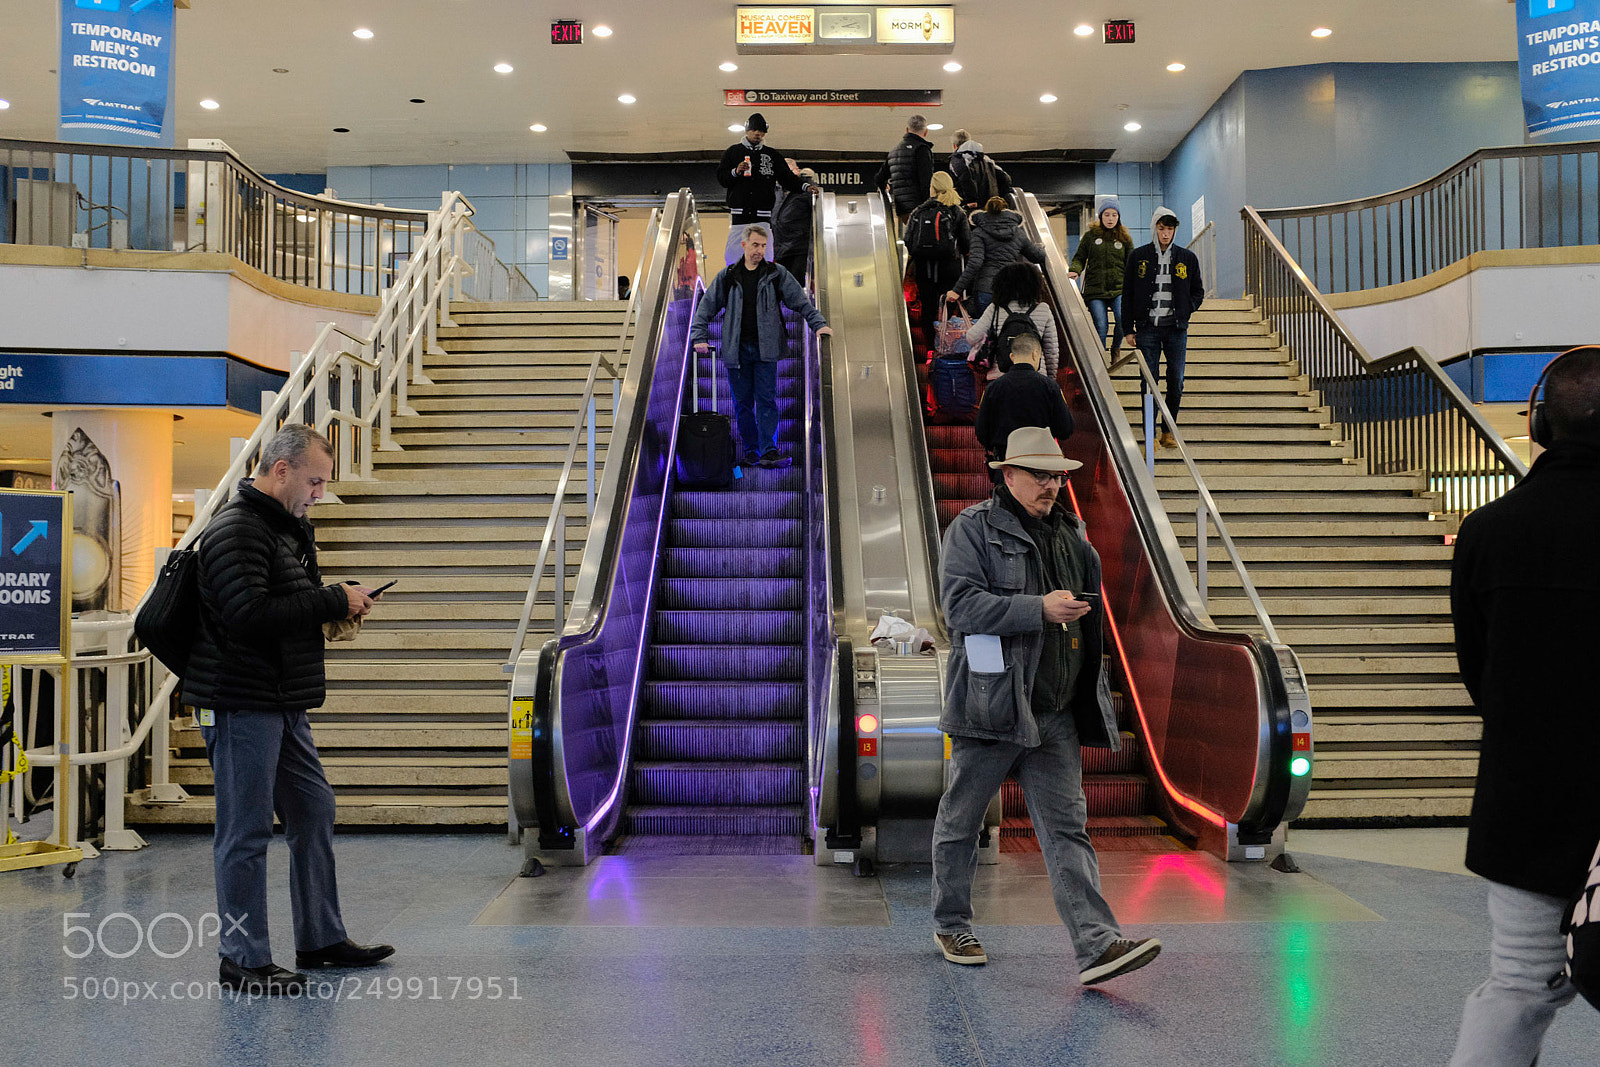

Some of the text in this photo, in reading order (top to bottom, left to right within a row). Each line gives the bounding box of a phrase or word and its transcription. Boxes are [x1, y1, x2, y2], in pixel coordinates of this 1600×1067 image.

[70, 22, 162, 47] TEMPORARY
[554, 25, 580, 41] EXIT
[741, 21, 812, 34] HEAVEN
[1107, 24, 1133, 40] EXIT
[1526, 20, 1600, 46] TEMPORA
[90, 39, 139, 58] MEN'S
[1549, 36, 1599, 56] MEN'S
[73, 54, 156, 77] RESTROOM
[1532, 51, 1600, 76] RESTROO
[727, 92, 860, 102] Exit To Taxiway and Street
[98, 101, 142, 111] AMTRAK
[813, 172, 864, 185] ARRIVED.
[0, 589, 51, 604] OOMS
[863, 743, 871, 752] 13
